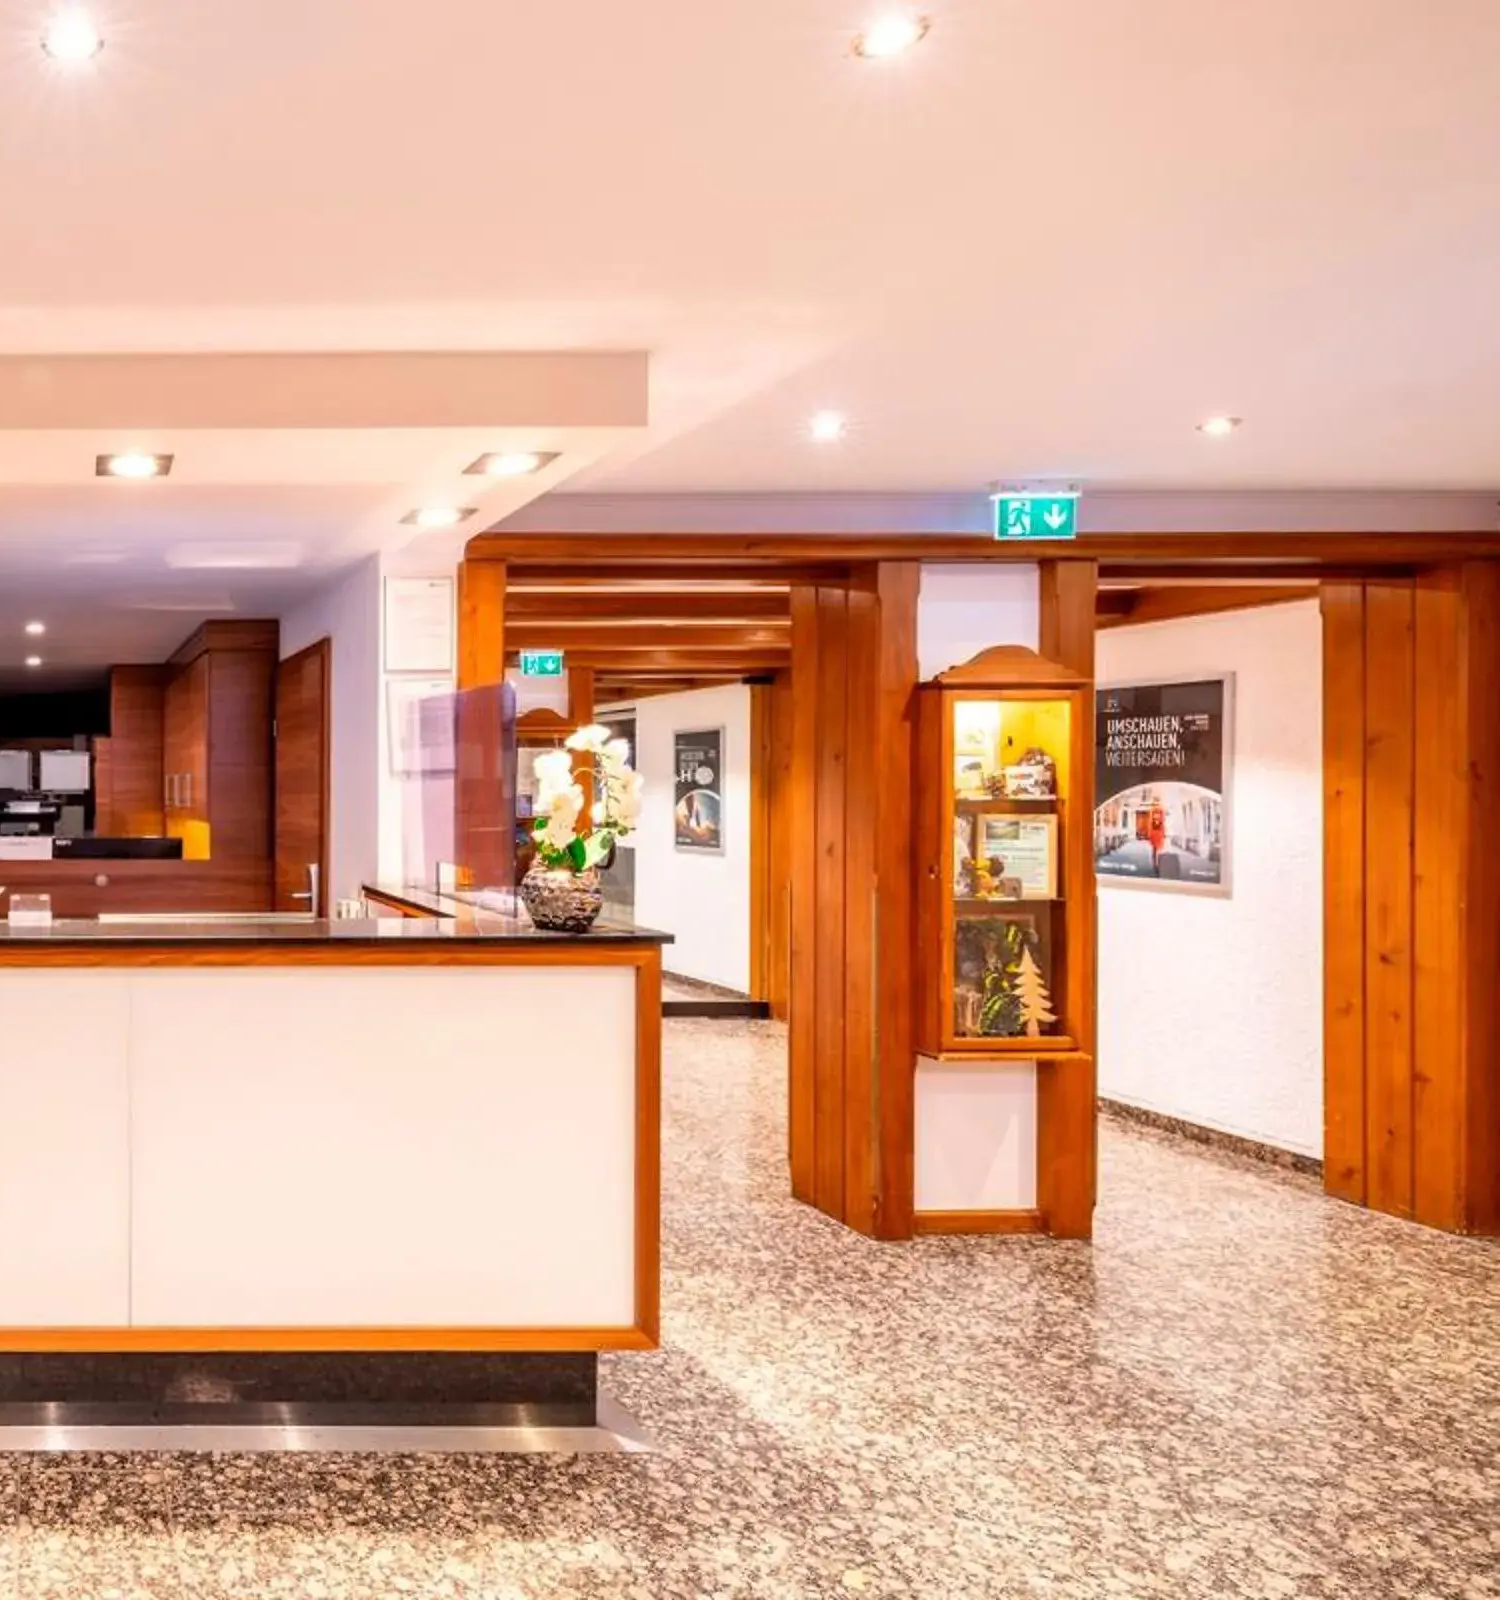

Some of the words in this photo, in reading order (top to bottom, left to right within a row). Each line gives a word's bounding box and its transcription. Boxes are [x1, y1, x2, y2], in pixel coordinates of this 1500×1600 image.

[1107, 715, 1184, 734] UMSCHAUEN,
[1107, 733, 1181, 749] ANSCHAUEN,
[1105, 750, 1185, 767] WEITERSAGEN!
